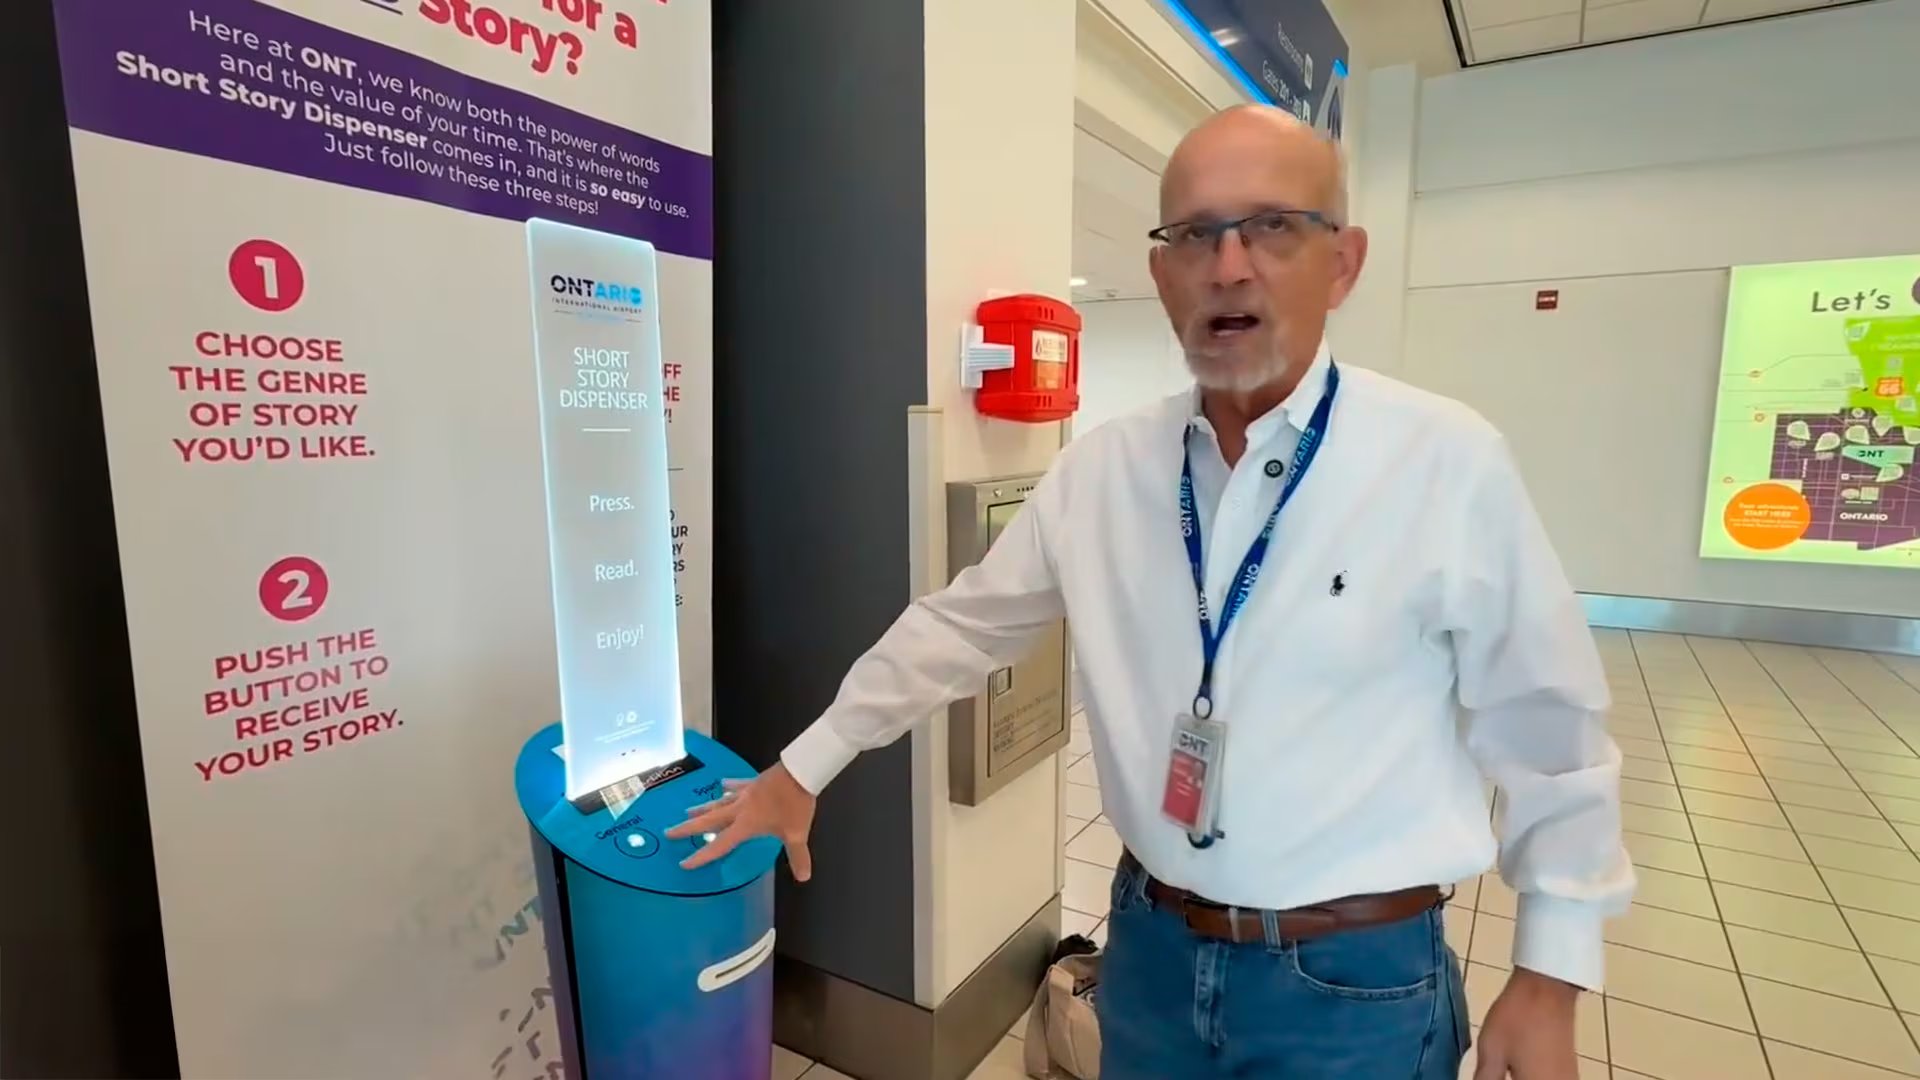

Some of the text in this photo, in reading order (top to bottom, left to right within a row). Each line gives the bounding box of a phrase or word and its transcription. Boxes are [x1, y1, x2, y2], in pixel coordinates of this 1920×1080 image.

[614, 12, 638, 49] a
[189, 10, 661, 174] Here at ONT, we know both the power of words
[115, 50, 690, 219] Short Story Dispenser comes in, and it is so easy to use.
[220, 52, 649, 189] and the value of your time. That's where the
[324, 132, 599, 216] Just follow these three steps!
[253, 255, 280, 299] 1
[1811, 288, 1891, 313] Let's
[195, 331, 344, 363] CHOOSE
[573, 347, 630, 369] SHORT
[168, 365, 368, 395] THE GENRE
[577, 368, 630, 389] STORY
[189, 402, 359, 427] OF STORY
[560, 389, 649, 410] DISPENSER
[172, 435, 377, 463] YOU'D LIKE.
[589, 495, 635, 512] Press.
[1840, 512, 1888, 521] ONTARIO
[594, 559, 639, 582] Read.
[277, 569, 313, 610] 2
[596, 624, 644, 650] Enjoy!
[214, 628, 377, 680] PUSH THE
[204, 655, 389, 715] BUTTON TO
[234, 688, 370, 740] RECEIVE
[194, 708, 404, 782] YOUR STORY.
[594, 815, 644, 840] General
